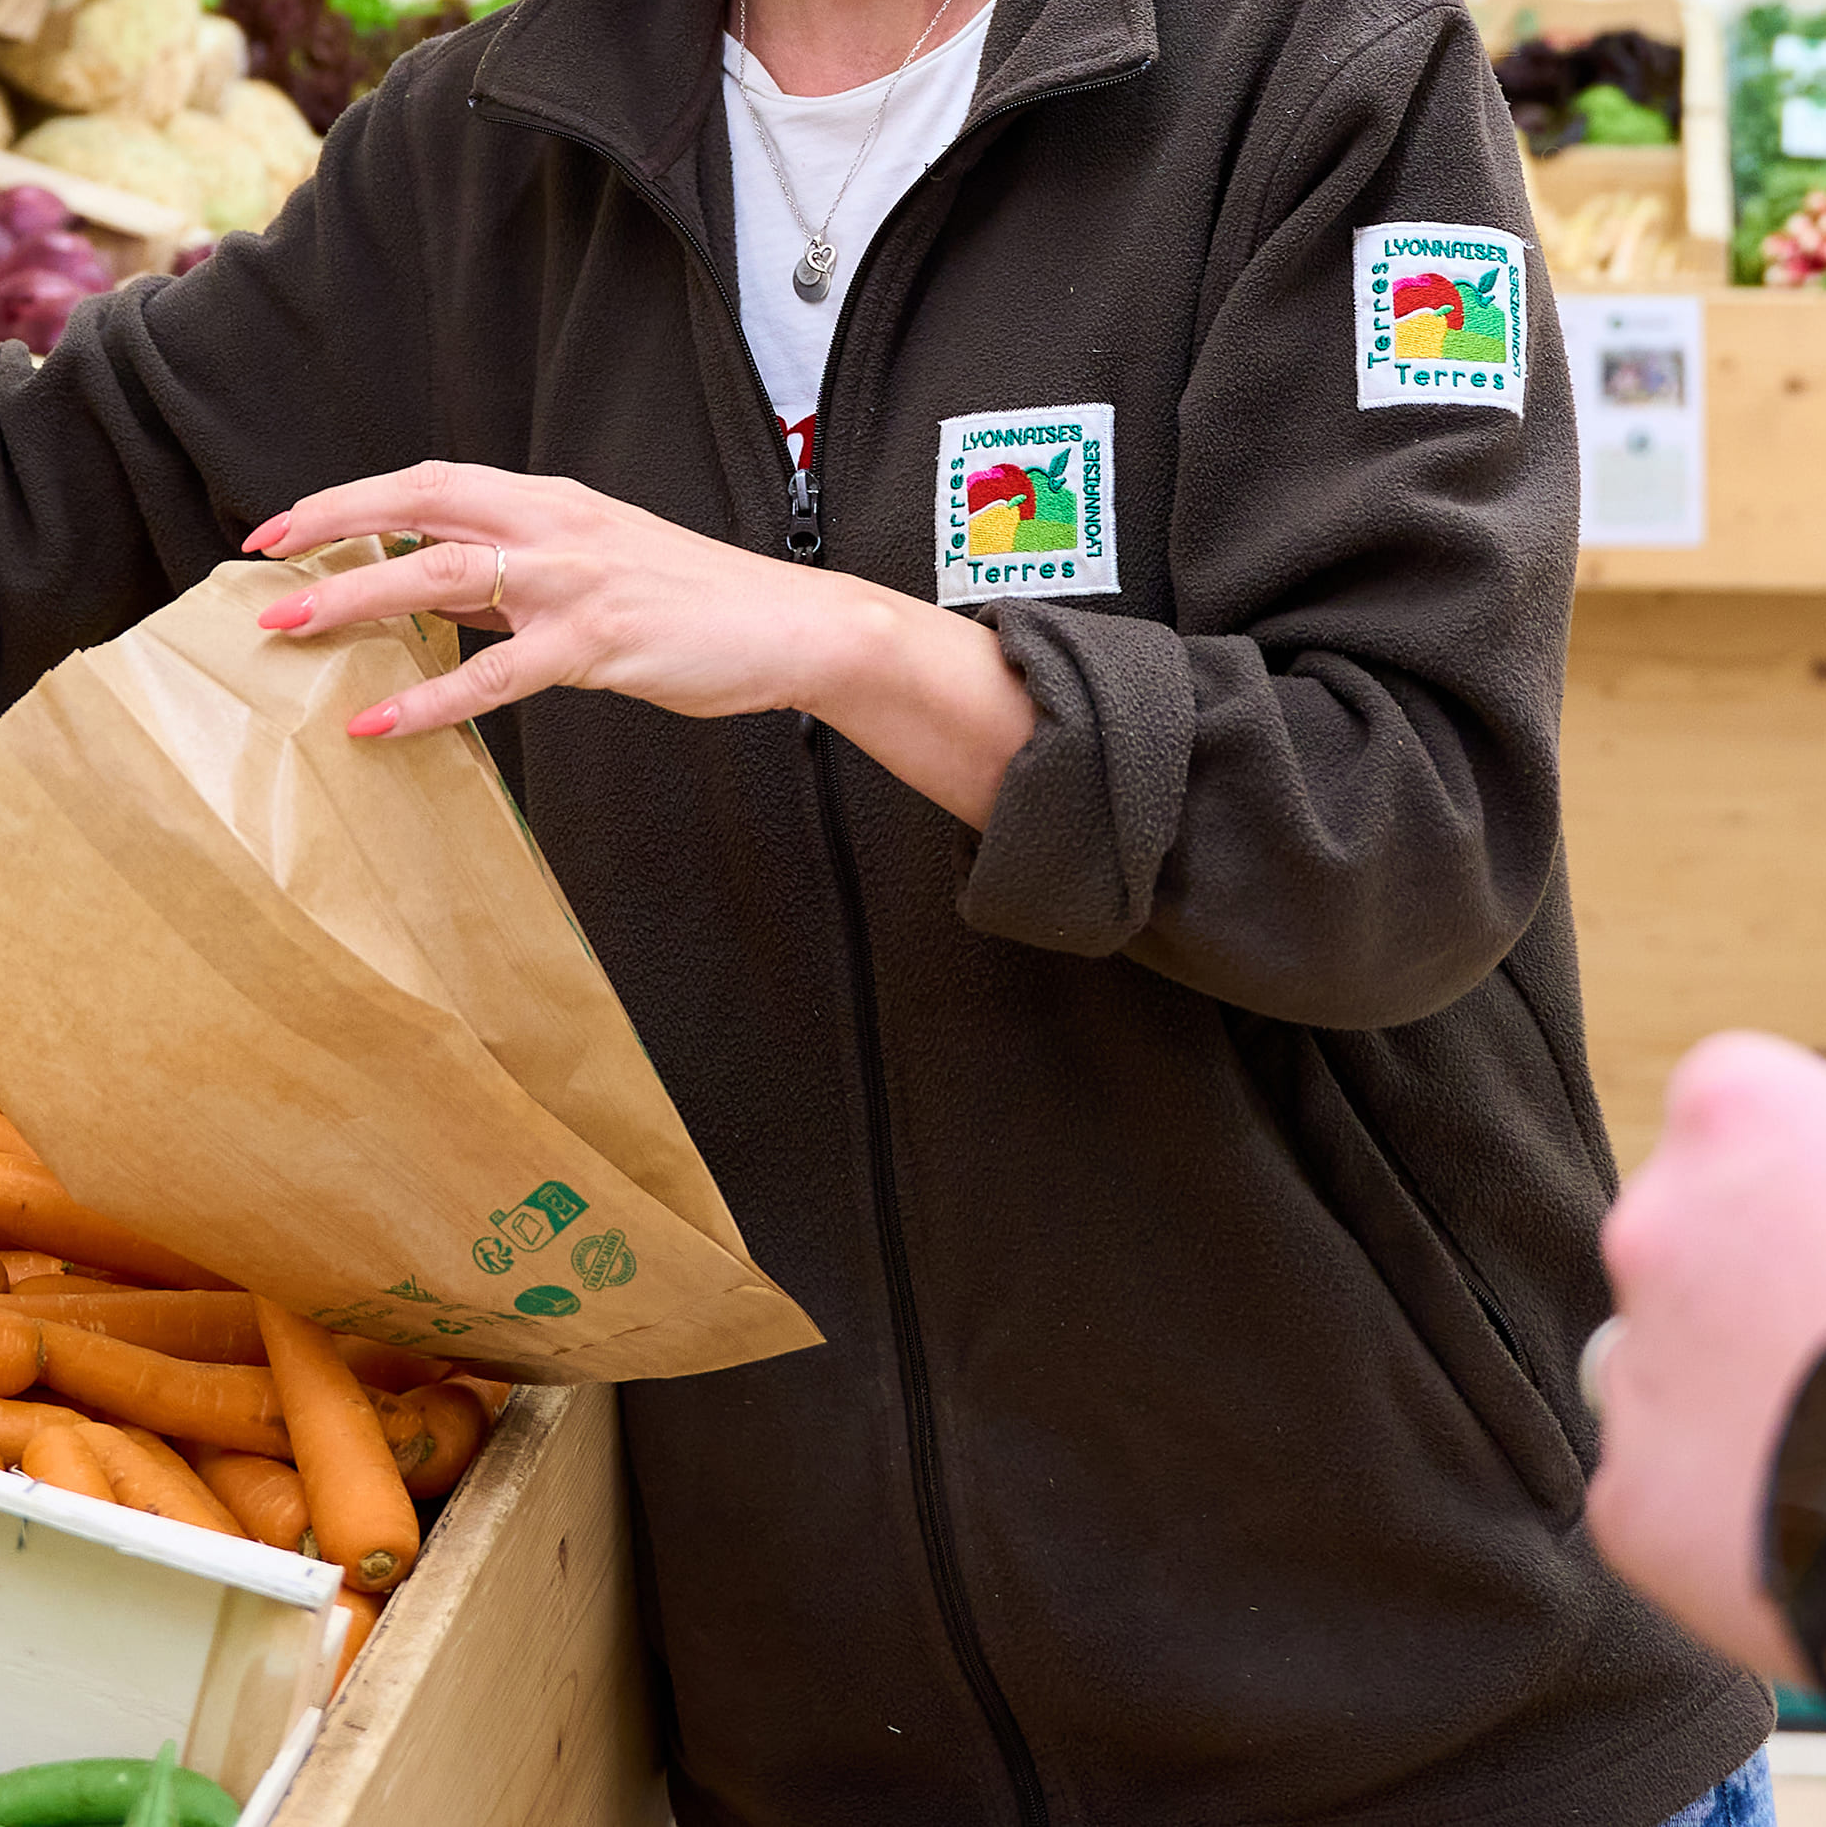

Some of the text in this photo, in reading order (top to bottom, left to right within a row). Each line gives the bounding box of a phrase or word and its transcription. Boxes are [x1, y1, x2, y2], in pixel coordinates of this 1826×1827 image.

[1384, 238, 1508, 264] LYONNAISES
[1367, 262, 1391, 369] Terres
[1508, 264, 1521, 378] LYONNAISES
[1394, 363, 1505, 390] Terres
[963, 424, 1083, 451] LYONNAISES
[945, 457, 966, 567] Terres
[1083, 440, 1102, 557] LYONNAISES
[967, 560, 1075, 584] Terres
